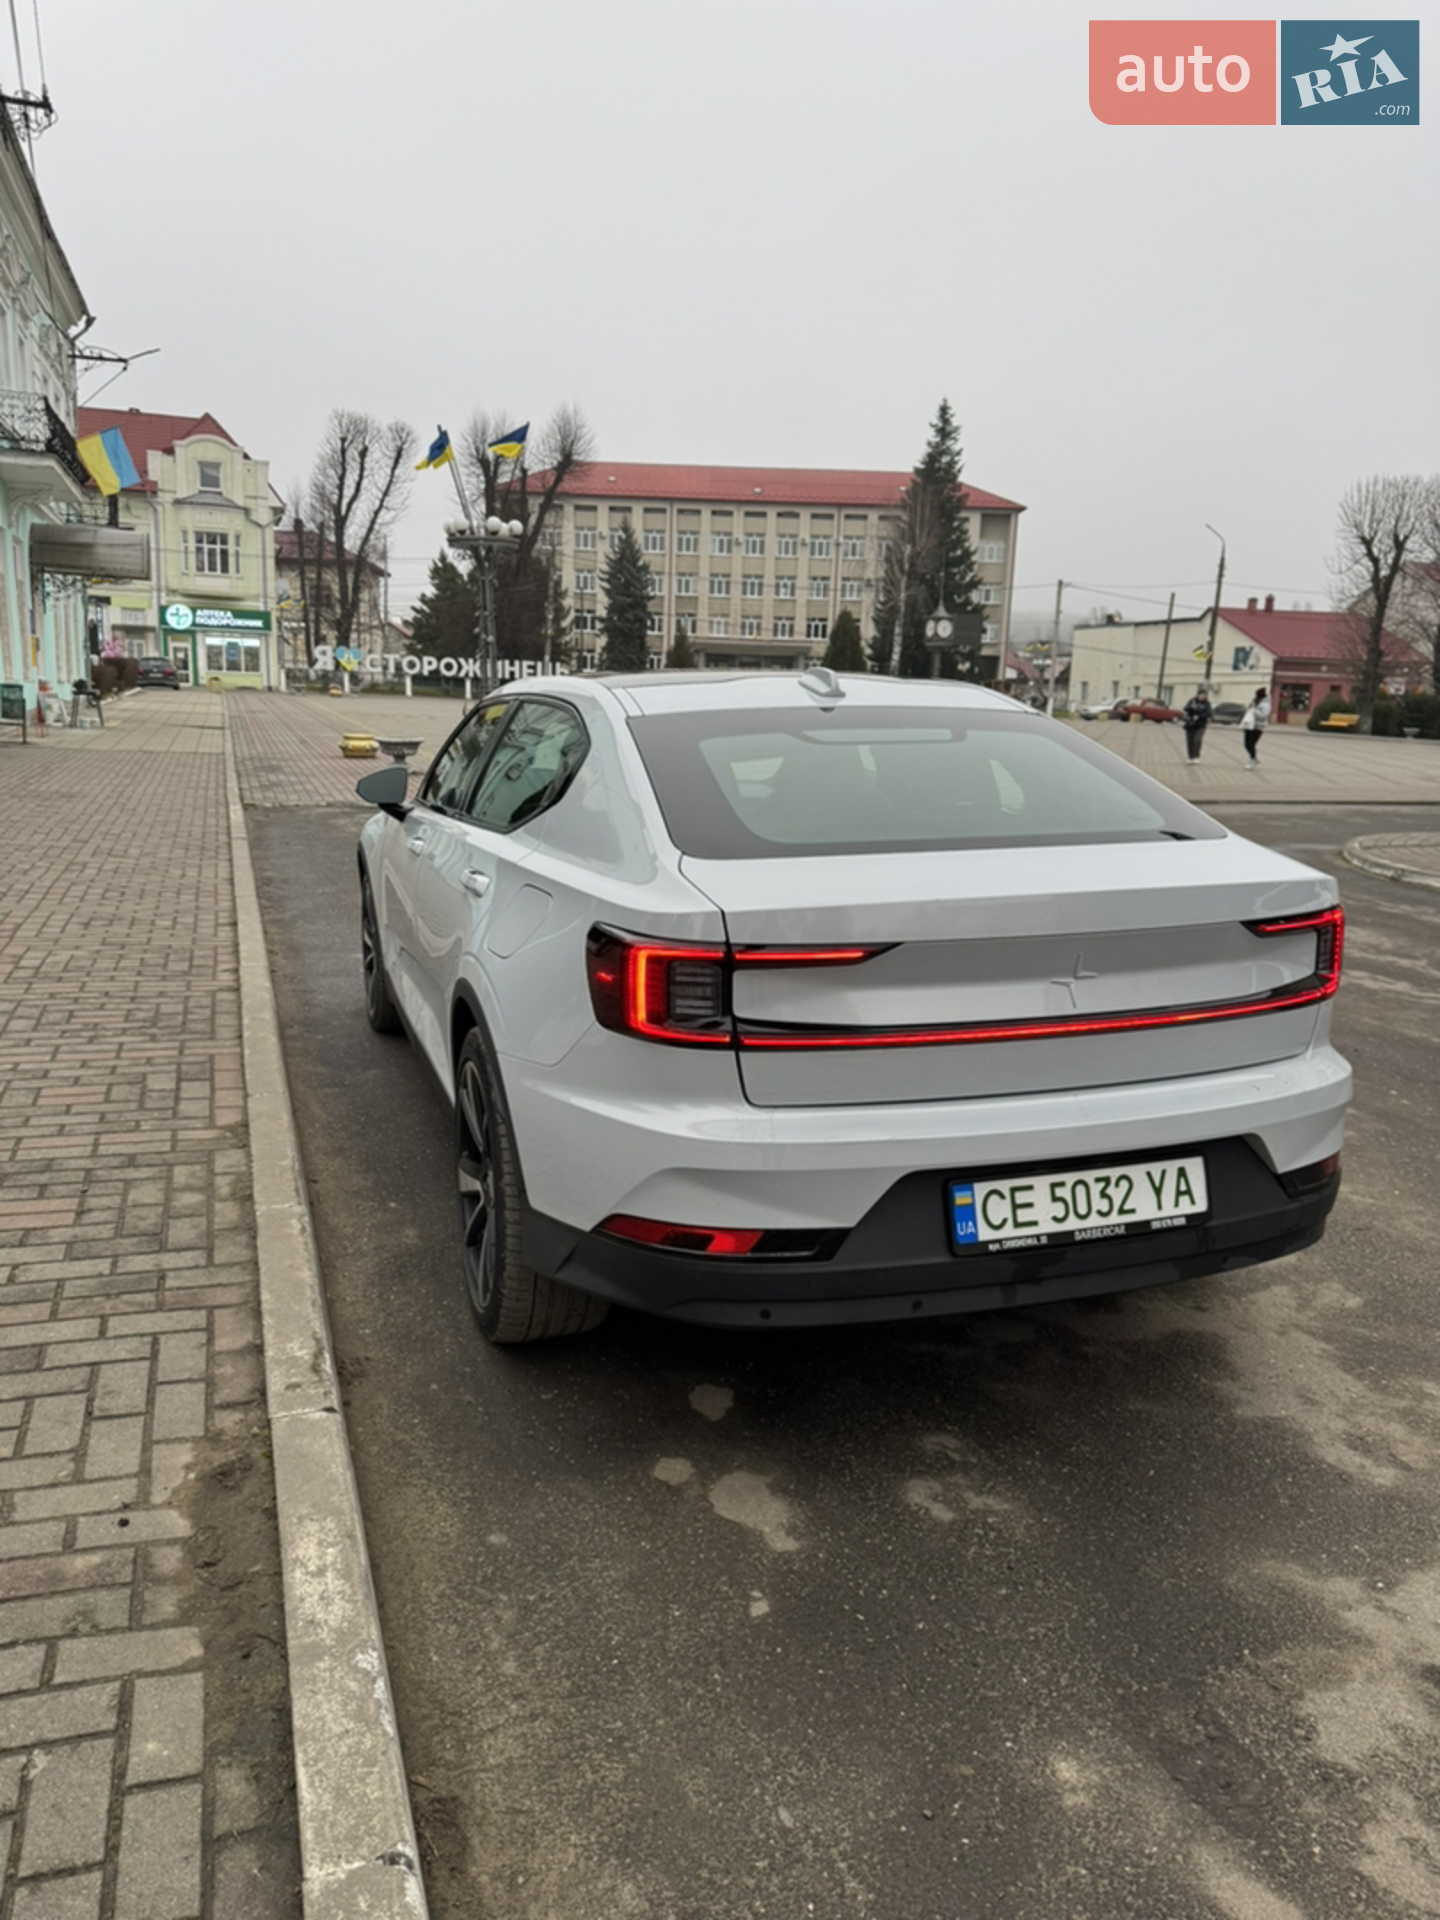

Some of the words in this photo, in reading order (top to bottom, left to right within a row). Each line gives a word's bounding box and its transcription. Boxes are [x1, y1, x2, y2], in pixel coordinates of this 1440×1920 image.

[313, 644, 334, 670] Я
[982, 1185, 1039, 1231] CE
[1050, 1174, 1137, 1224] 5032
[1146, 1166, 1196, 1211] YA
[957, 1221, 976, 1236] UA
